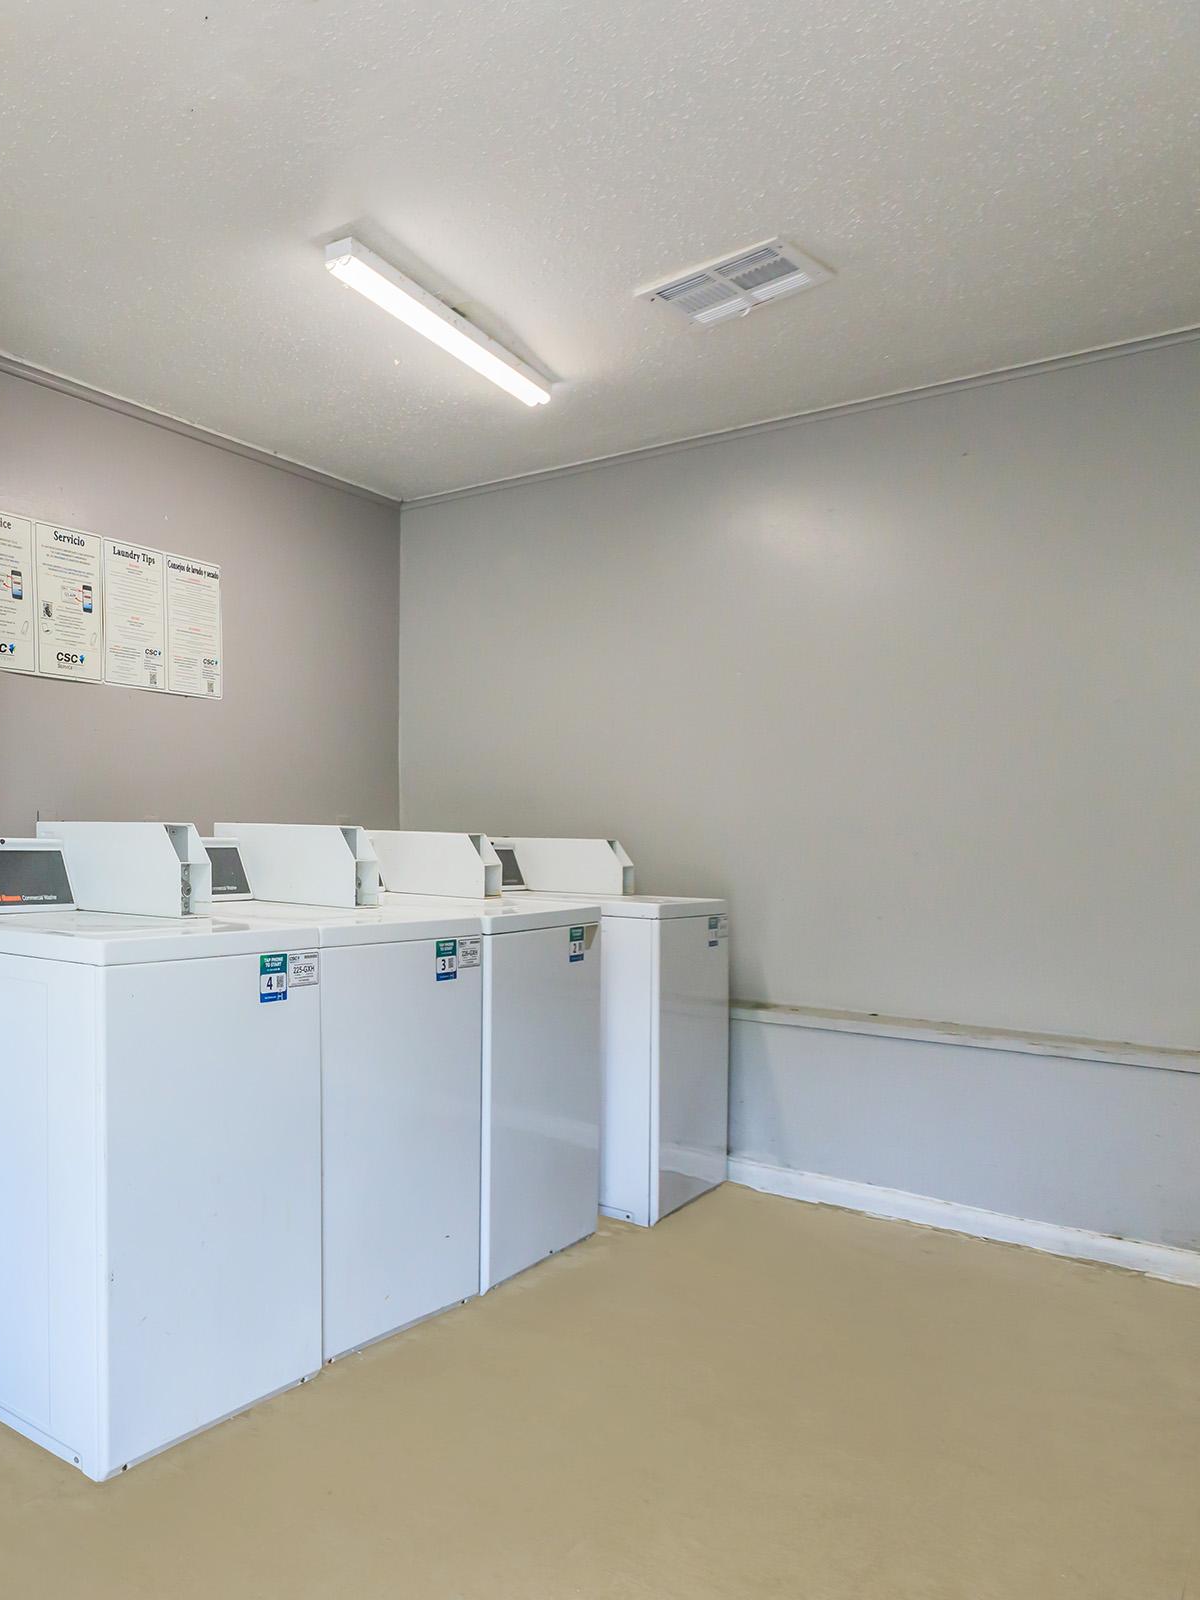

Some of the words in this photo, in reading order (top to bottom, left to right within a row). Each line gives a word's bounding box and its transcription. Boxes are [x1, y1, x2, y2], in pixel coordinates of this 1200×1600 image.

[53, 530, 85, 547] Servicio
[112, 545, 141, 563] Laundry
[141, 552, 156, 566] Tips
[167, 559, 186, 573] Consejos
[185, 564, 191, 573] de
[56, 651, 79, 664] CSC
[144, 648, 158, 657] CSC
[202, 658, 215, 666] CSC
[441, 958, 447, 971] 3
[266, 976, 273, 990] 4
